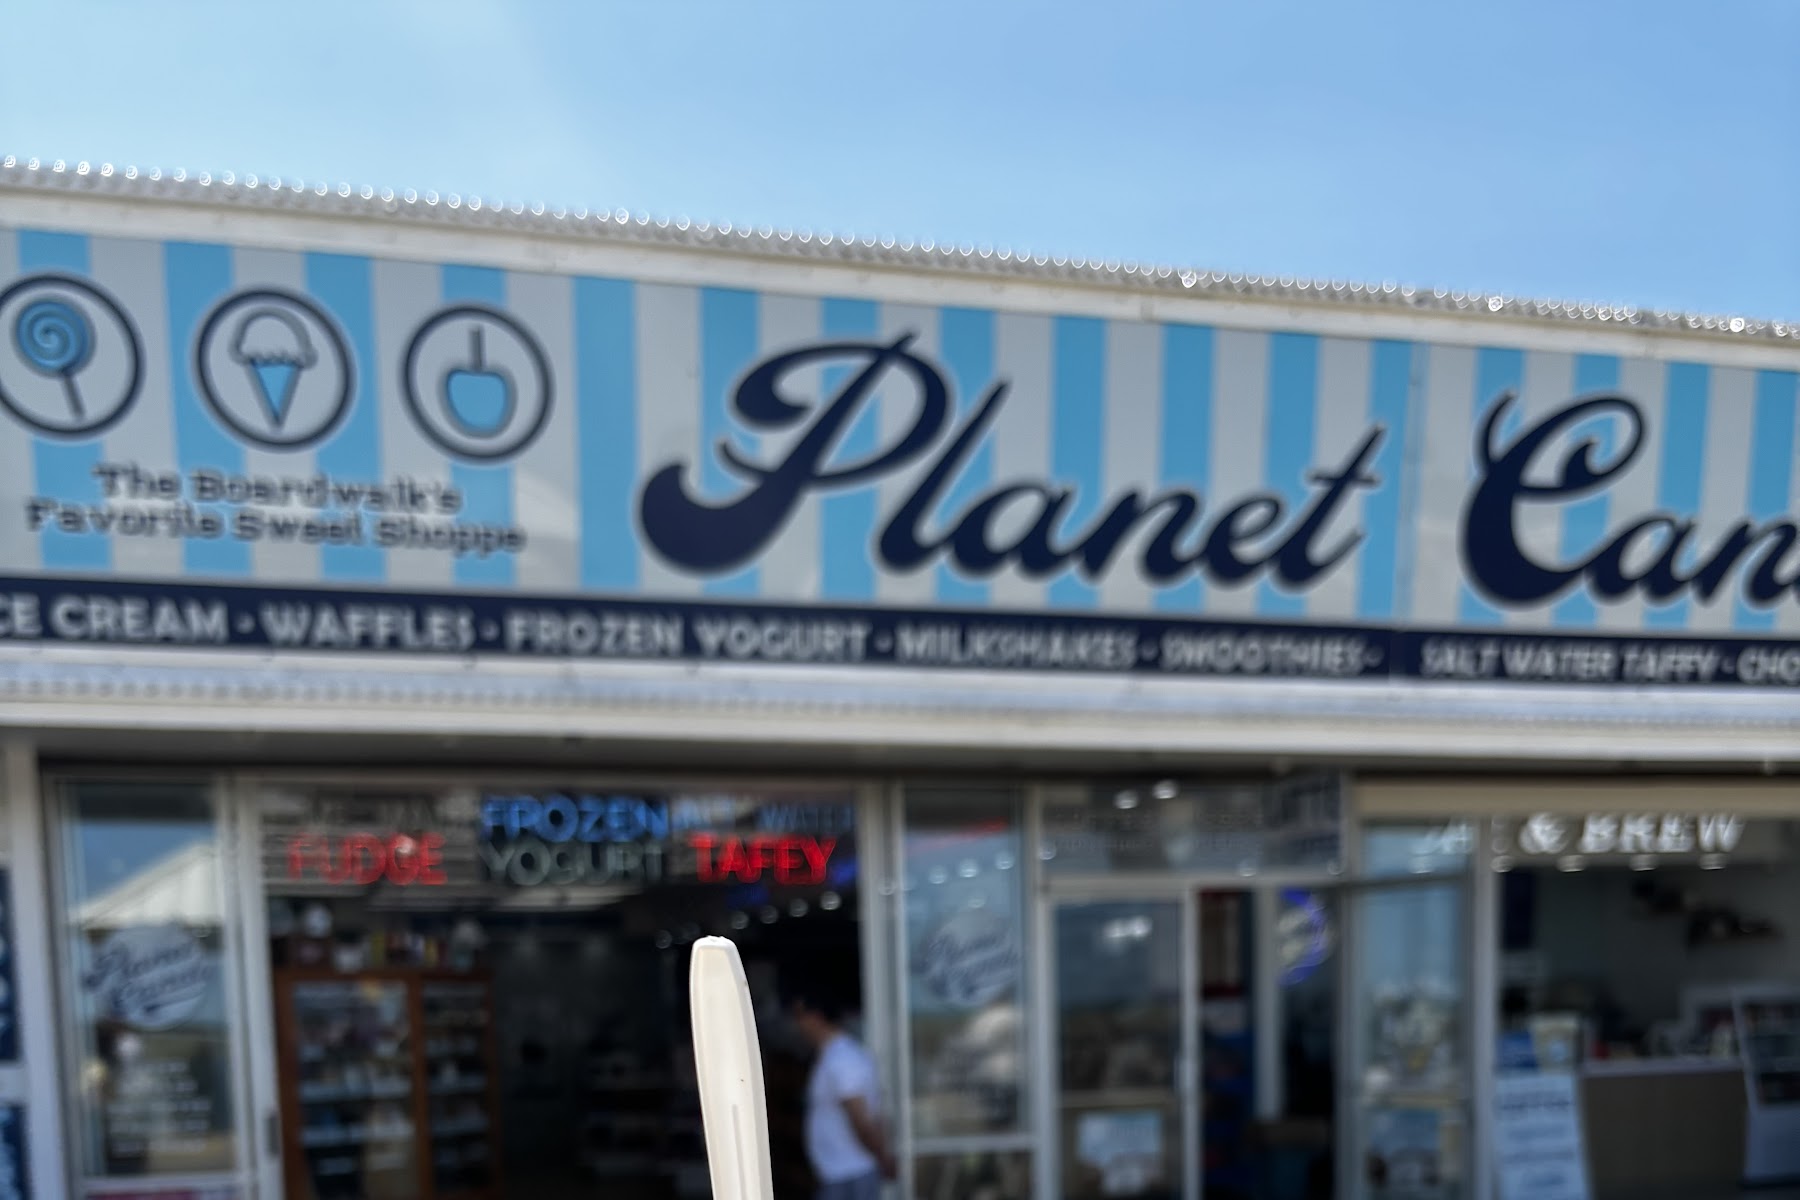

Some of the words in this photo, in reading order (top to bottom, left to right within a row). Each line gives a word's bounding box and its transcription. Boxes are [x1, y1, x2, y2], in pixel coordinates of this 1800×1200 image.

[638, 331, 1386, 592] Planet
[93, 463, 181, 498] The
[192, 469, 462, 514] Boardwalk's
[27, 498, 223, 539] Favorite
[233, 507, 361, 546] Sweet
[375, 516, 527, 559] Shoppe
[0, 592, 42, 637] E
[50, 593, 229, 643] CREAM
[260, 600, 476, 649] WAFFLES
[507, 607, 685, 656] FROZEN
[694, 613, 870, 661] YOGURT
[898, 621, 1138, 668] MILKSHAKES
[1160, 630, 1365, 675] SMOOTHIES
[1421, 638, 1499, 677] SALT
[1502, 640, 1617, 680] WATER
[1621, 643, 1720, 683] TAFFY
[481, 794, 669, 843] FROZEN
[1579, 813, 1746, 854] BREW
[287, 832, 447, 886] FUDGE
[478, 838, 664, 886] YOGURT
[688, 831, 837, 884] TAFFY
